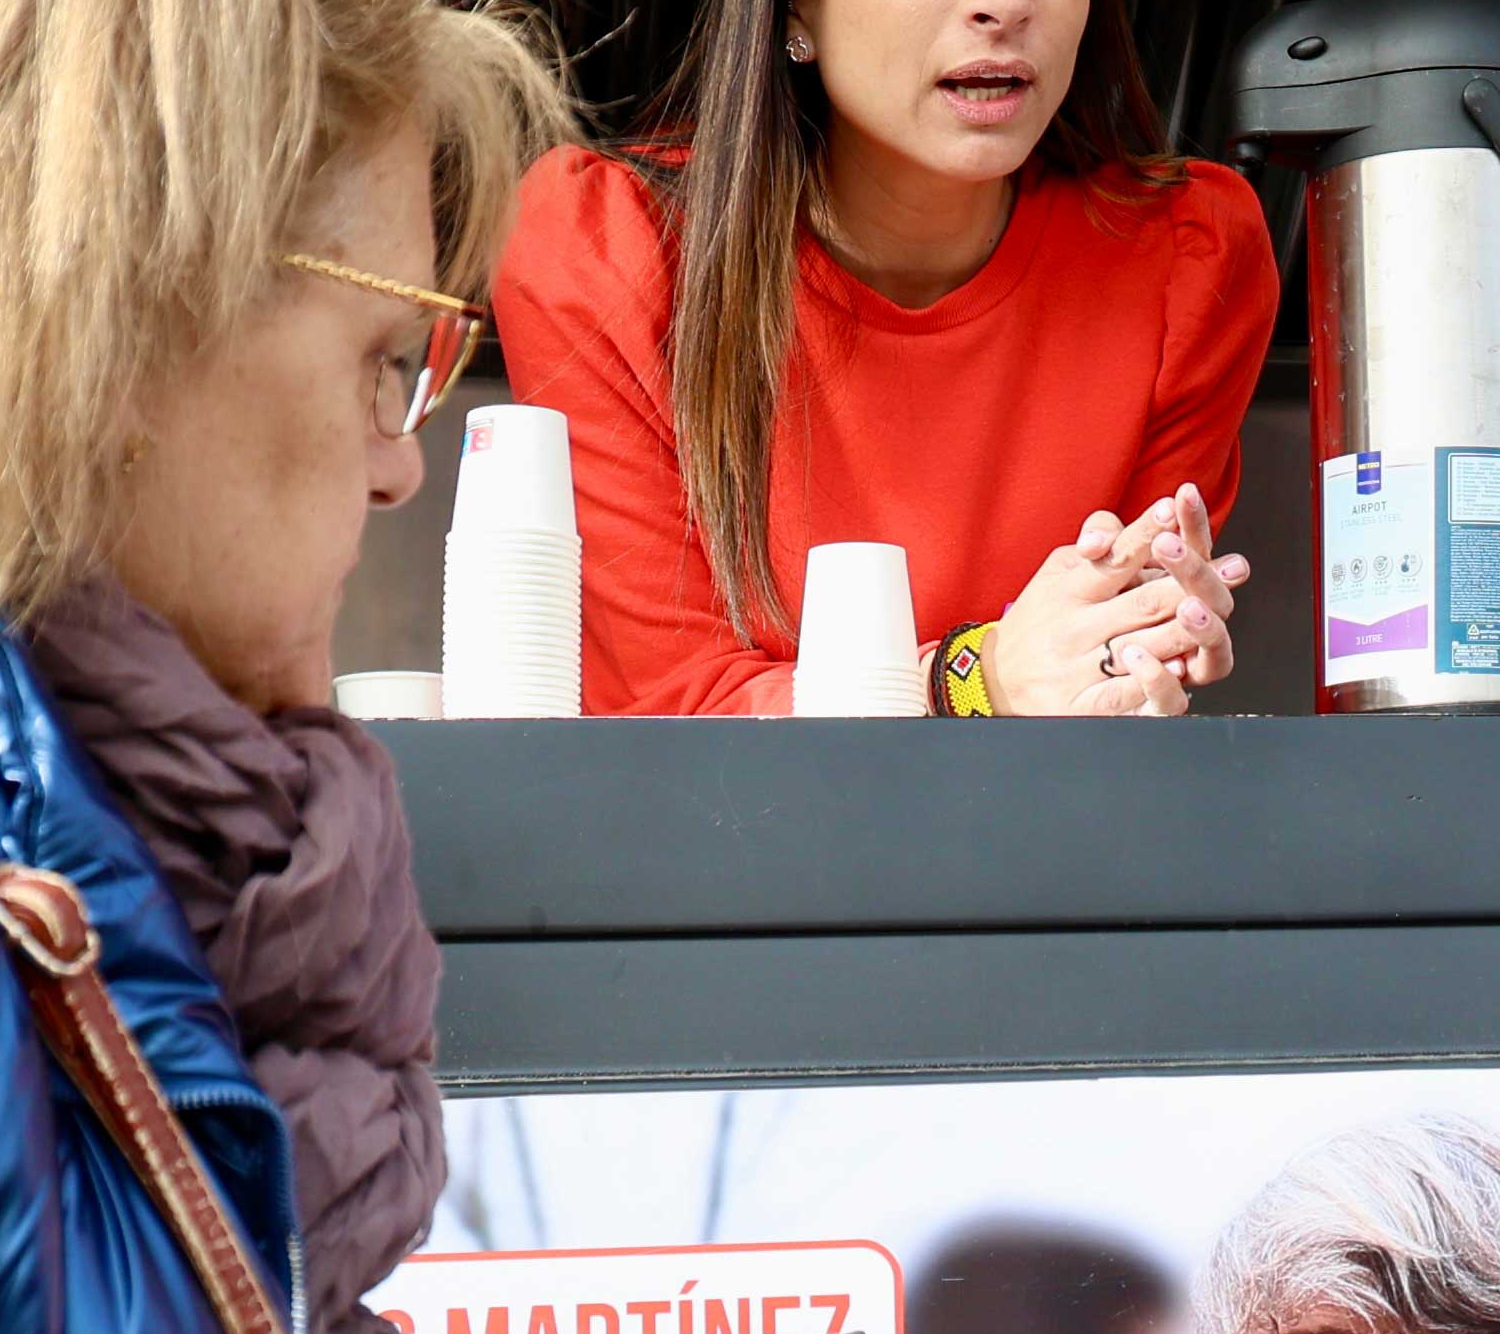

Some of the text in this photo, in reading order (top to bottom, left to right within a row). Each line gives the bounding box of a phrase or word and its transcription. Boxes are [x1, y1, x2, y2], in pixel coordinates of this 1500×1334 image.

[1351, 501, 1388, 515] AIRPOT
[1356, 633, 1384, 645] 3 LITRE
